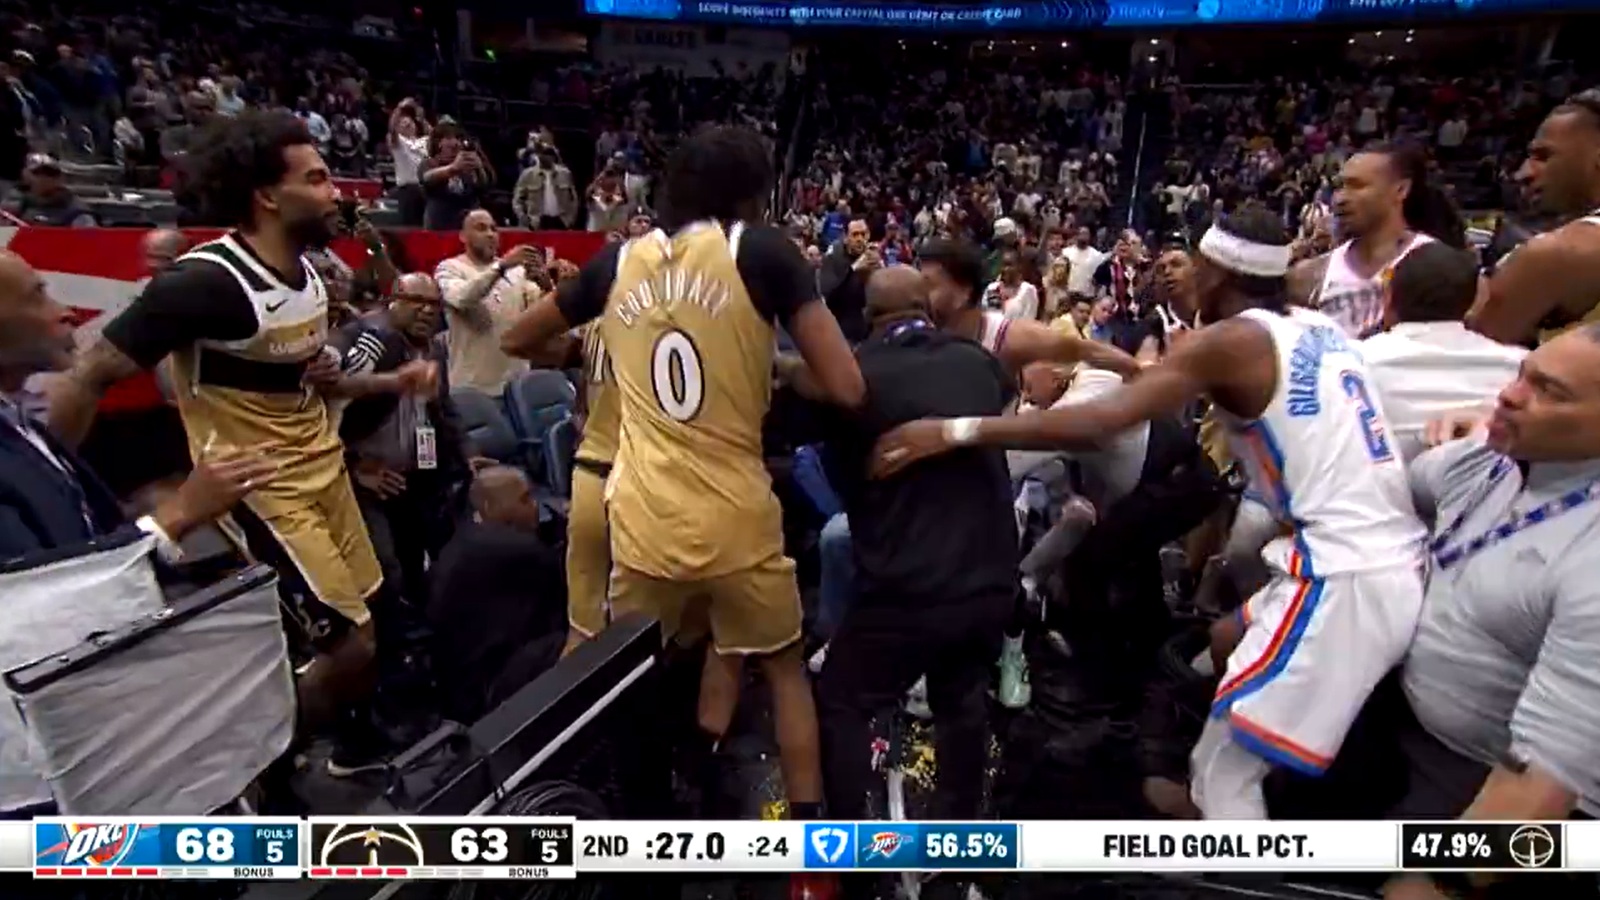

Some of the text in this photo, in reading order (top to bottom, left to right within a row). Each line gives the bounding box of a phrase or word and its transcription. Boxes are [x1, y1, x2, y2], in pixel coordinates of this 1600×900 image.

[789, 7, 814, 19] WITH
[816, 7, 843, 19] YOUR
[844, 7, 884, 19] CAPITAL
[651, 326, 706, 422] 0
[1339, 369, 1394, 463] 2
